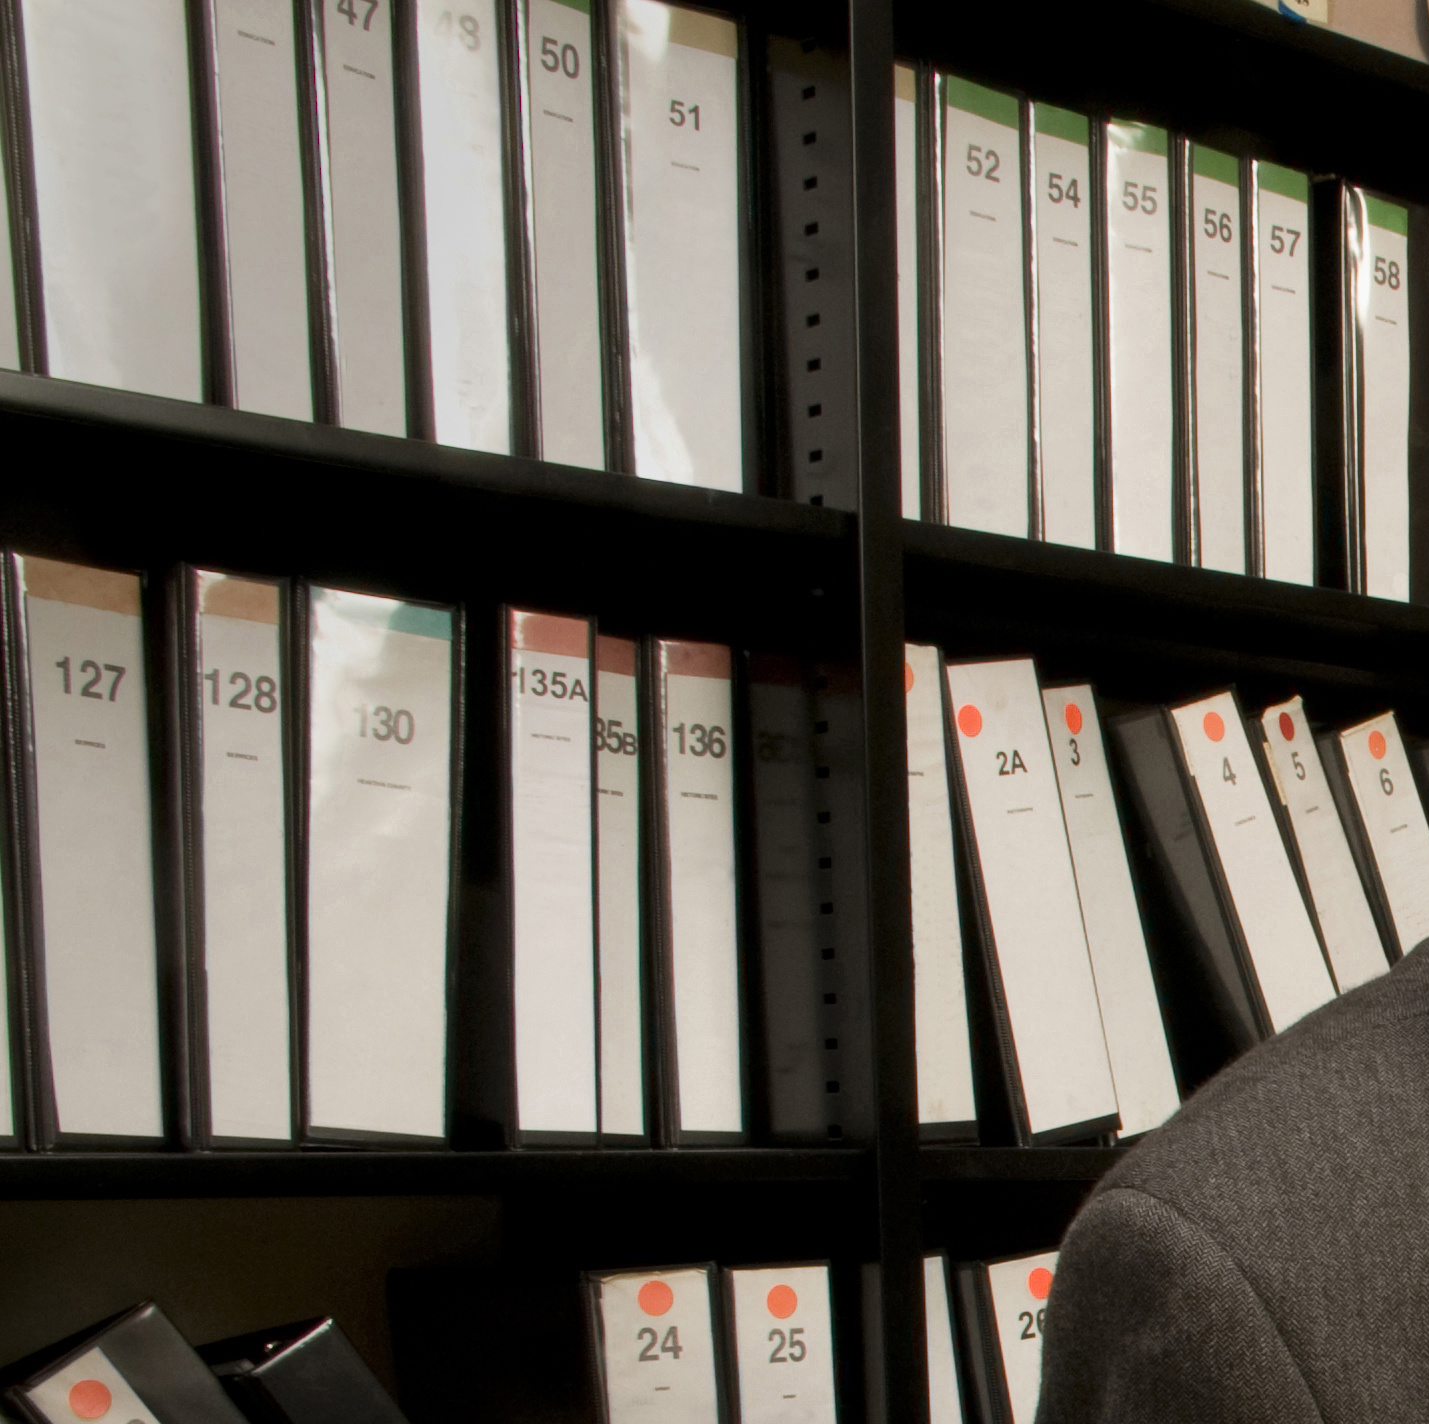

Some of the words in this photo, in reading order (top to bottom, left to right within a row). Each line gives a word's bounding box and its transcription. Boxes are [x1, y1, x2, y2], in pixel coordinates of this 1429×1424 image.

[337, 0, 379, 31] 47
[540, 36, 580, 80] 50
[668, 99, 703, 131] 51
[966, 143, 1001, 183] 52
[1048, 172, 1081, 208] 54
[1122, 181, 1158, 215] 55
[1203, 207, 1232, 243] 56
[1270, 223, 1301, 258] 57
[1374, 256, 1400, 291] 58
[55, 656, 126, 702] 127
[204, 668, 278, 714] 128
[512, 666, 588, 702] 135A
[353, 703, 415, 745] 130
[672, 722, 727, 759] 136
[996, 750, 1028, 776] 2A
[1070, 738, 1081, 766] 3
[1291, 752, 1306, 781] 5
[1222, 757, 1237, 785] 4
[1379, 768, 1394, 796] 6
[637, 1325, 683, 1362] 24
[767, 1327, 807, 1363] 25
